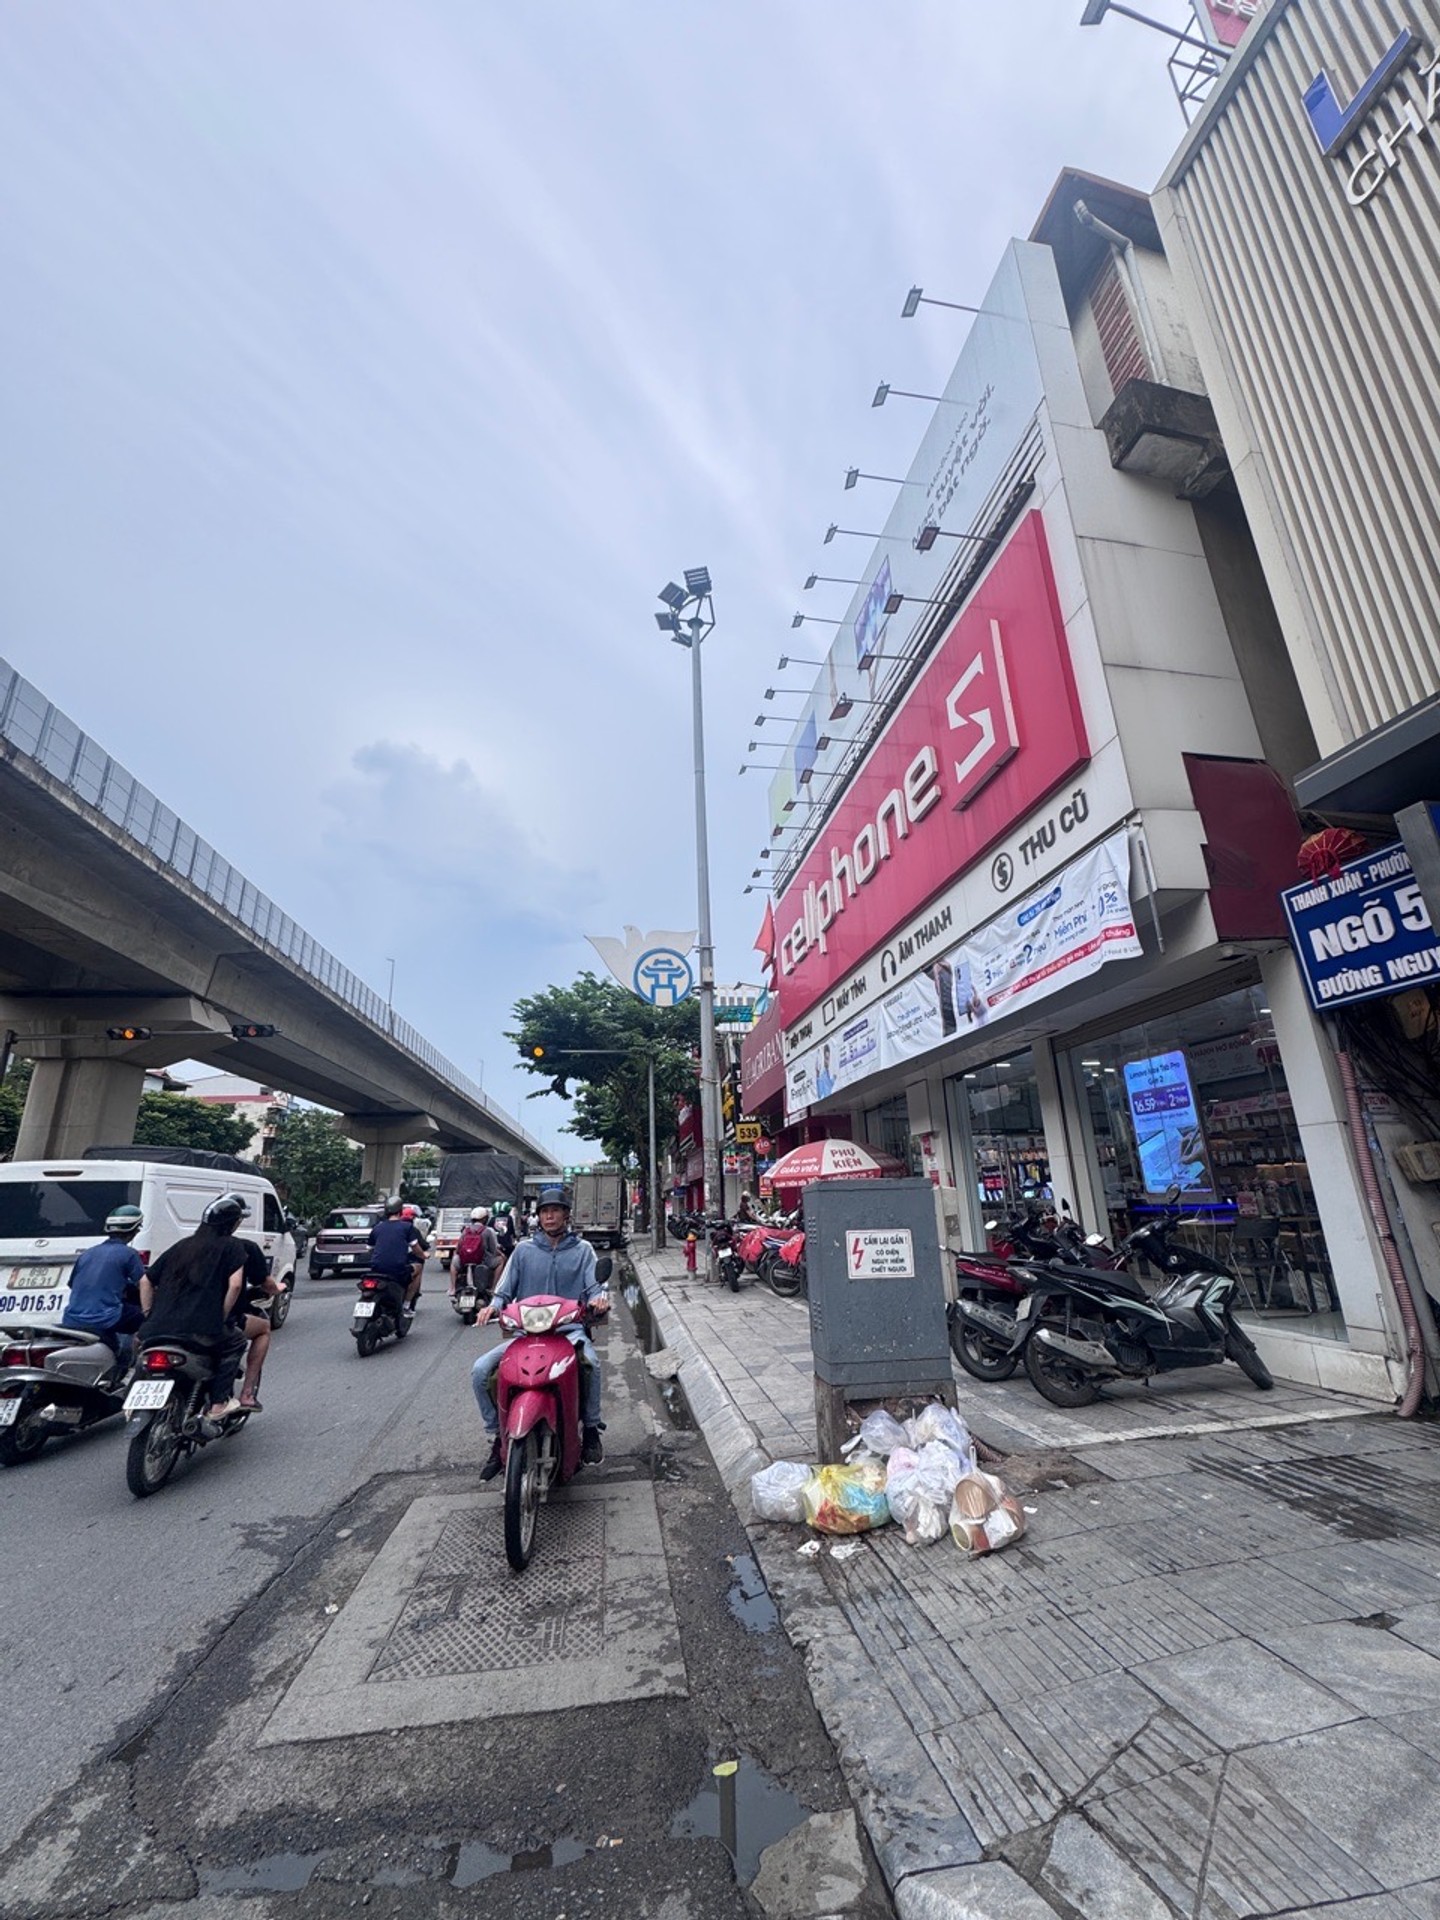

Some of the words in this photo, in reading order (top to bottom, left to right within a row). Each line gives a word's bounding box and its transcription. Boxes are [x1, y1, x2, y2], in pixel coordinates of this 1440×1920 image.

[1018, 817, 1057, 866] THU
[1060, 788, 1089, 834] CŨ
[1290, 886, 1330, 913] THANH
[1327, 872, 1364, 898] XUÂN
[914, 905, 953, 954] THANH
[1308, 898, 1396, 962] NGÕ
[1022, 944, 1033, 965] 2
[1317, 965, 1385, 999] ĐƯỜNG
[740, 1127, 759, 1140] 539
[830, 1148, 856, 1160] PHỤ
[833, 1156, 862, 1169] KIỆN
